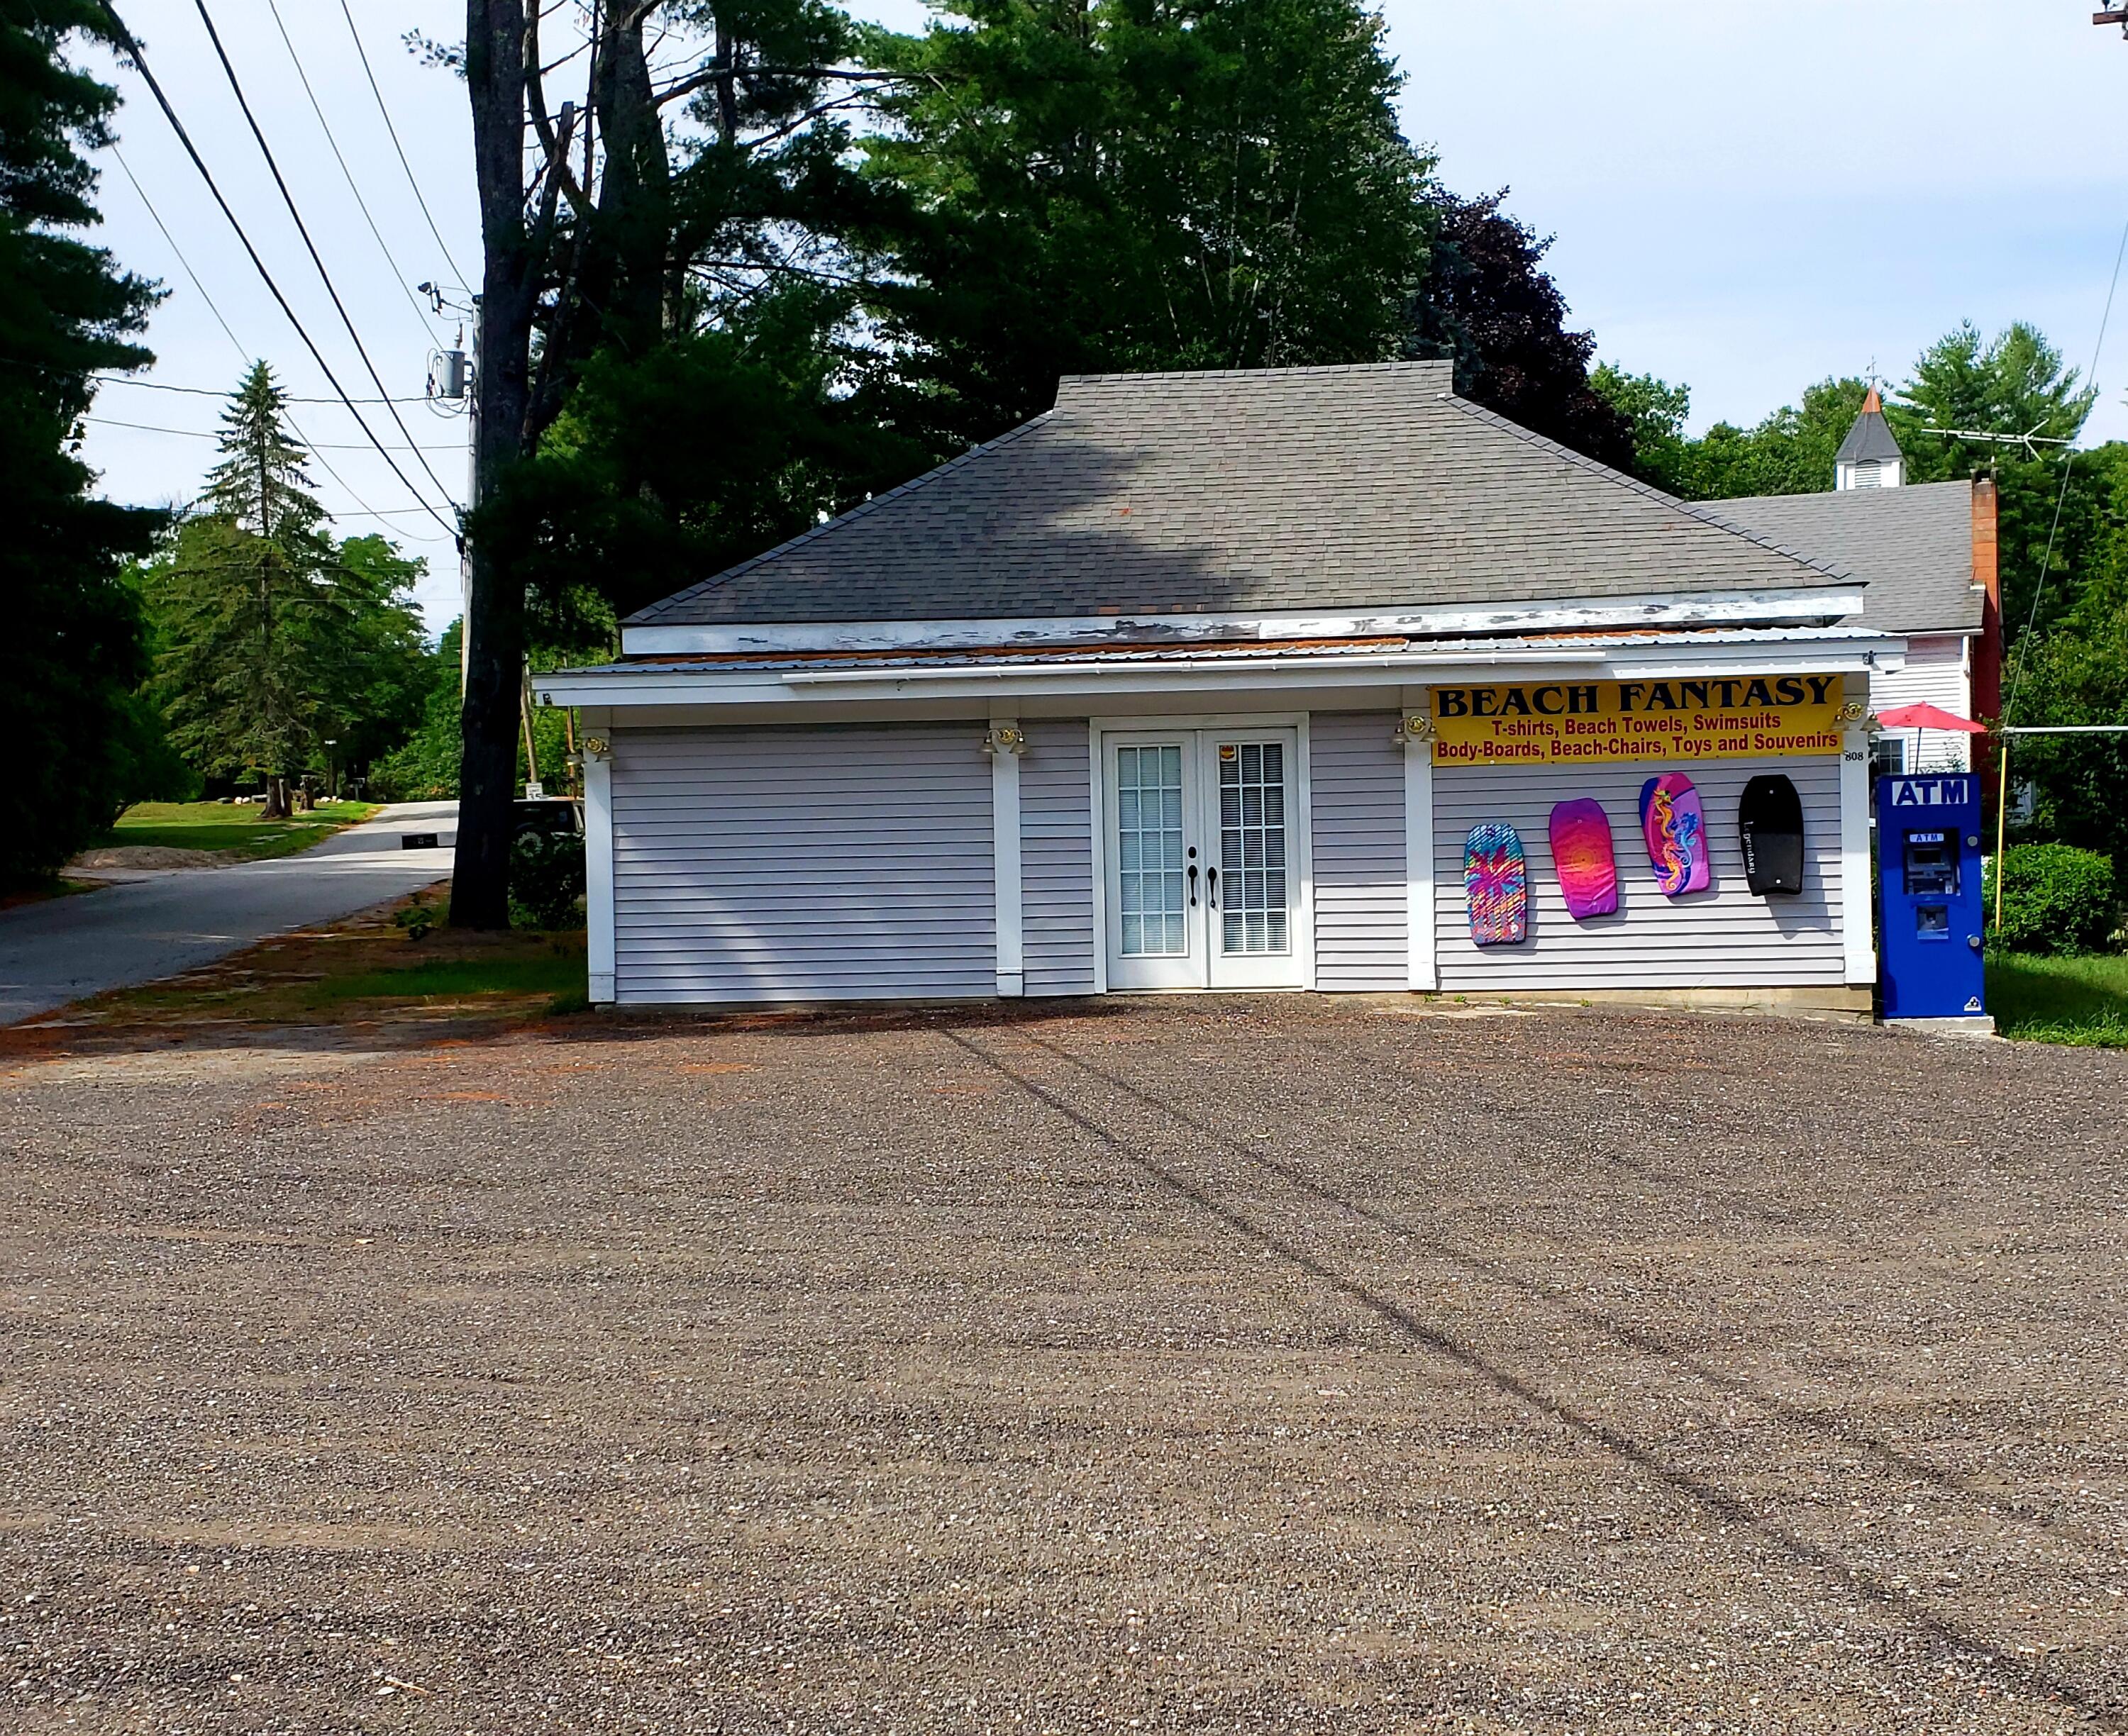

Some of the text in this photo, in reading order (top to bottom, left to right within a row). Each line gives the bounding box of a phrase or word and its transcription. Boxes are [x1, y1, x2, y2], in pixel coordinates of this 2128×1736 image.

[1436, 677, 1836, 717] BEACH FANTASY
[1492, 712, 1781, 738] T-shirts, Beach Towels, Swimsuits
[1437, 730, 1838, 761] Body-Boards, Beach-Chairs, Toys and Souvenirs
[1845, 751, 1863, 761] 808
[1896, 780, 1965, 804] ATM
